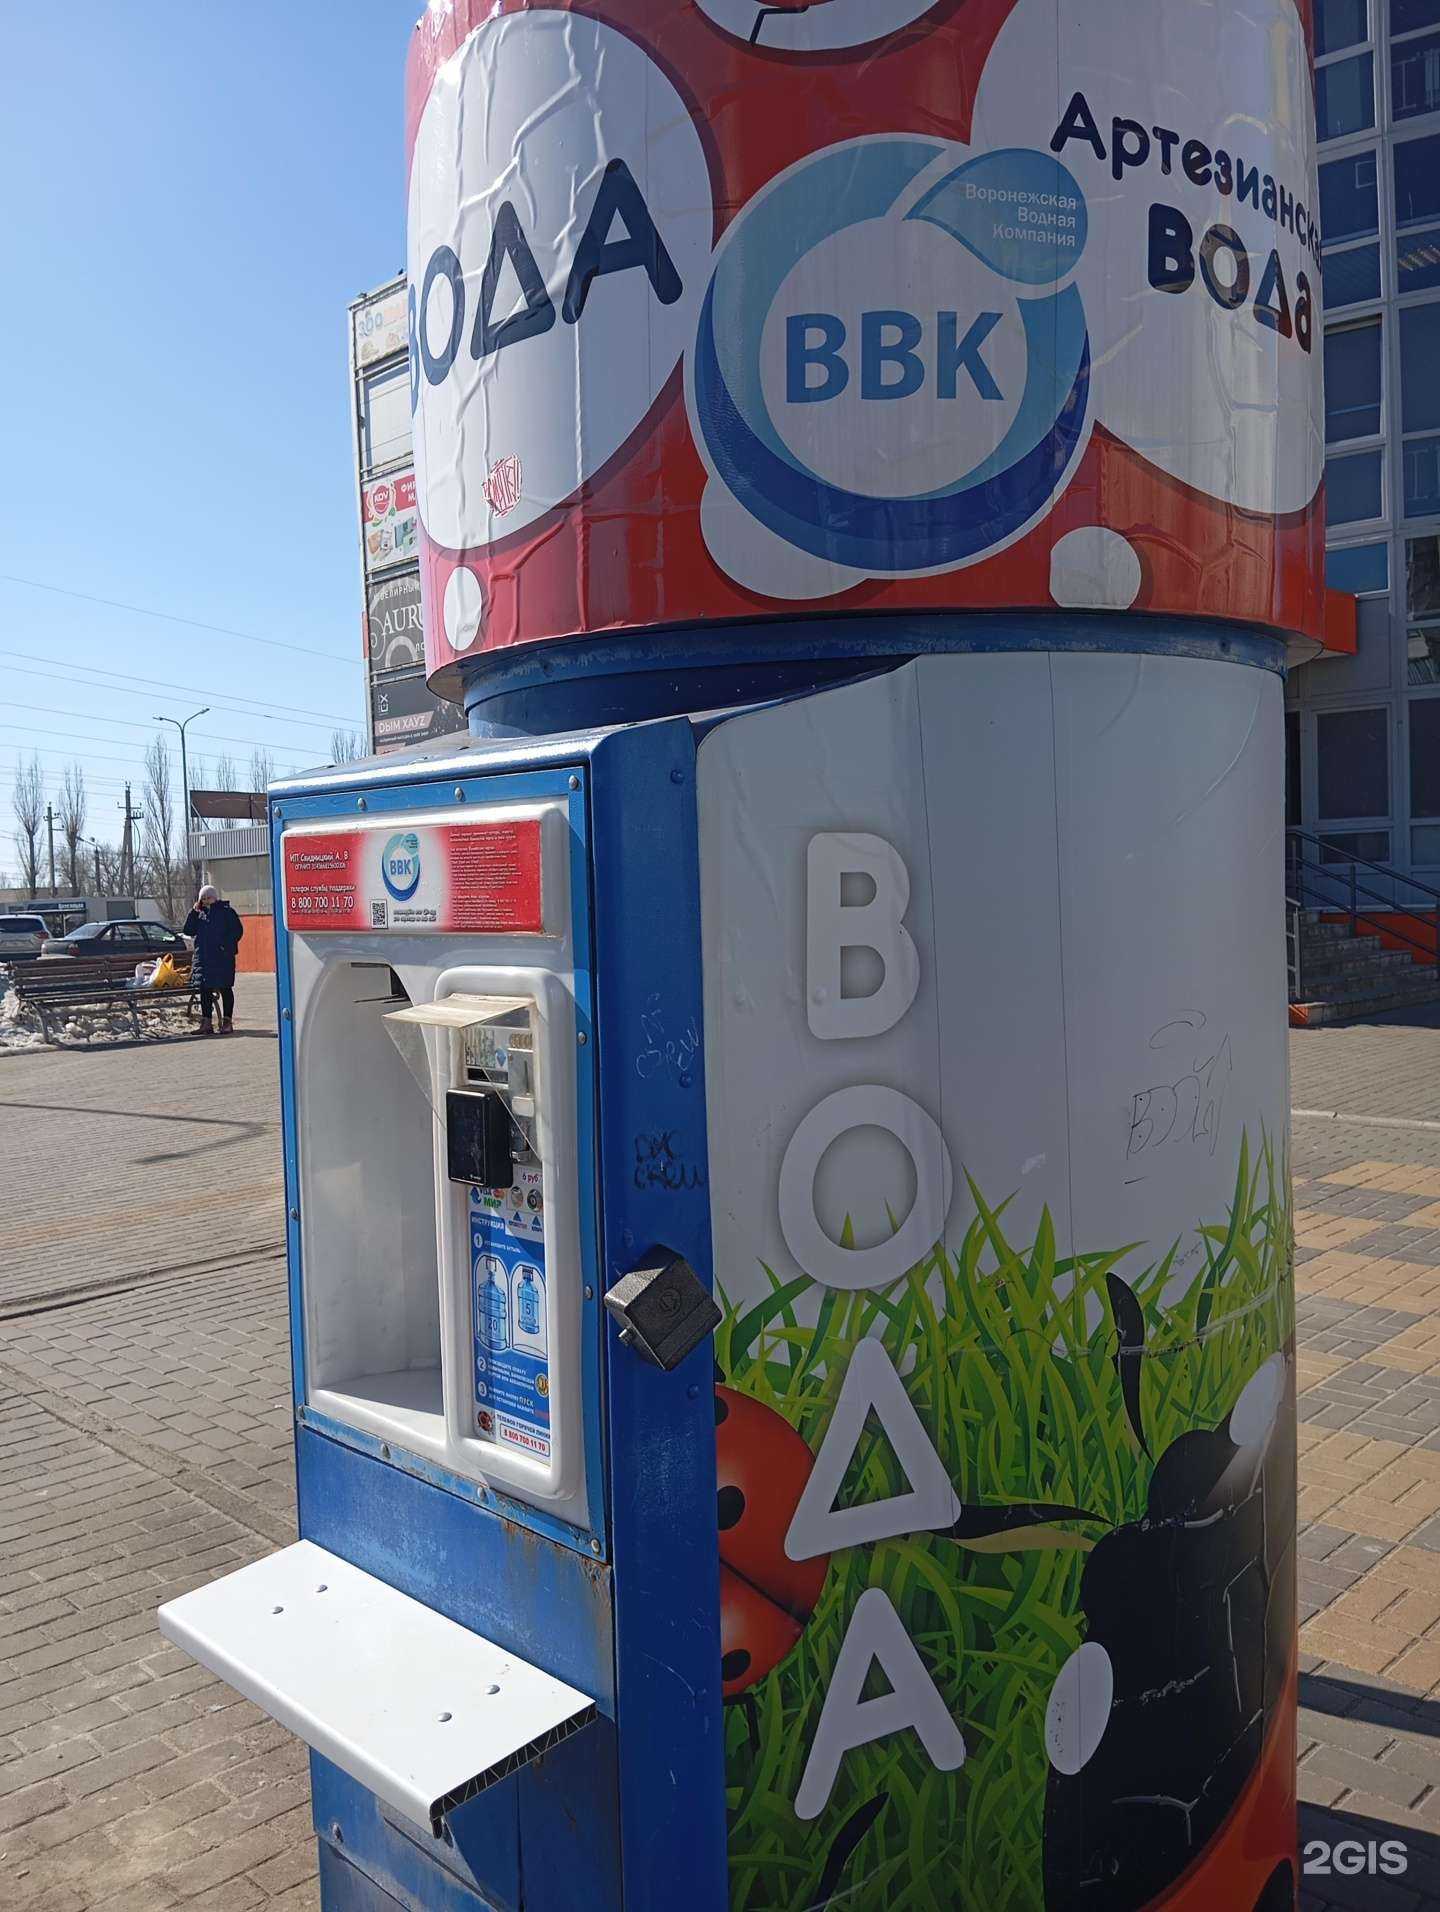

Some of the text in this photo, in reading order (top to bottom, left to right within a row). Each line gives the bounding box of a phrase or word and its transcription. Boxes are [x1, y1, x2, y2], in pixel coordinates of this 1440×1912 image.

[965, 183, 1077, 209] Воронежская
[1017, 206, 1076, 228] Водная
[992, 223, 1076, 247] Компания
[785, 310, 1004, 403] ВВК
[289, 853, 299, 862] ИП
[389, 859, 411, 875] ВВК
[291, 895, 354, 908] 8 800 700 11 70
[525, 1303, 531, 1315] 5
[488, 1318, 497, 1331] 20
[778, 832, 966, 1820] ВОДА
[508, 1430, 519, 1440] 800
[519, 1434, 529, 1445] 700
